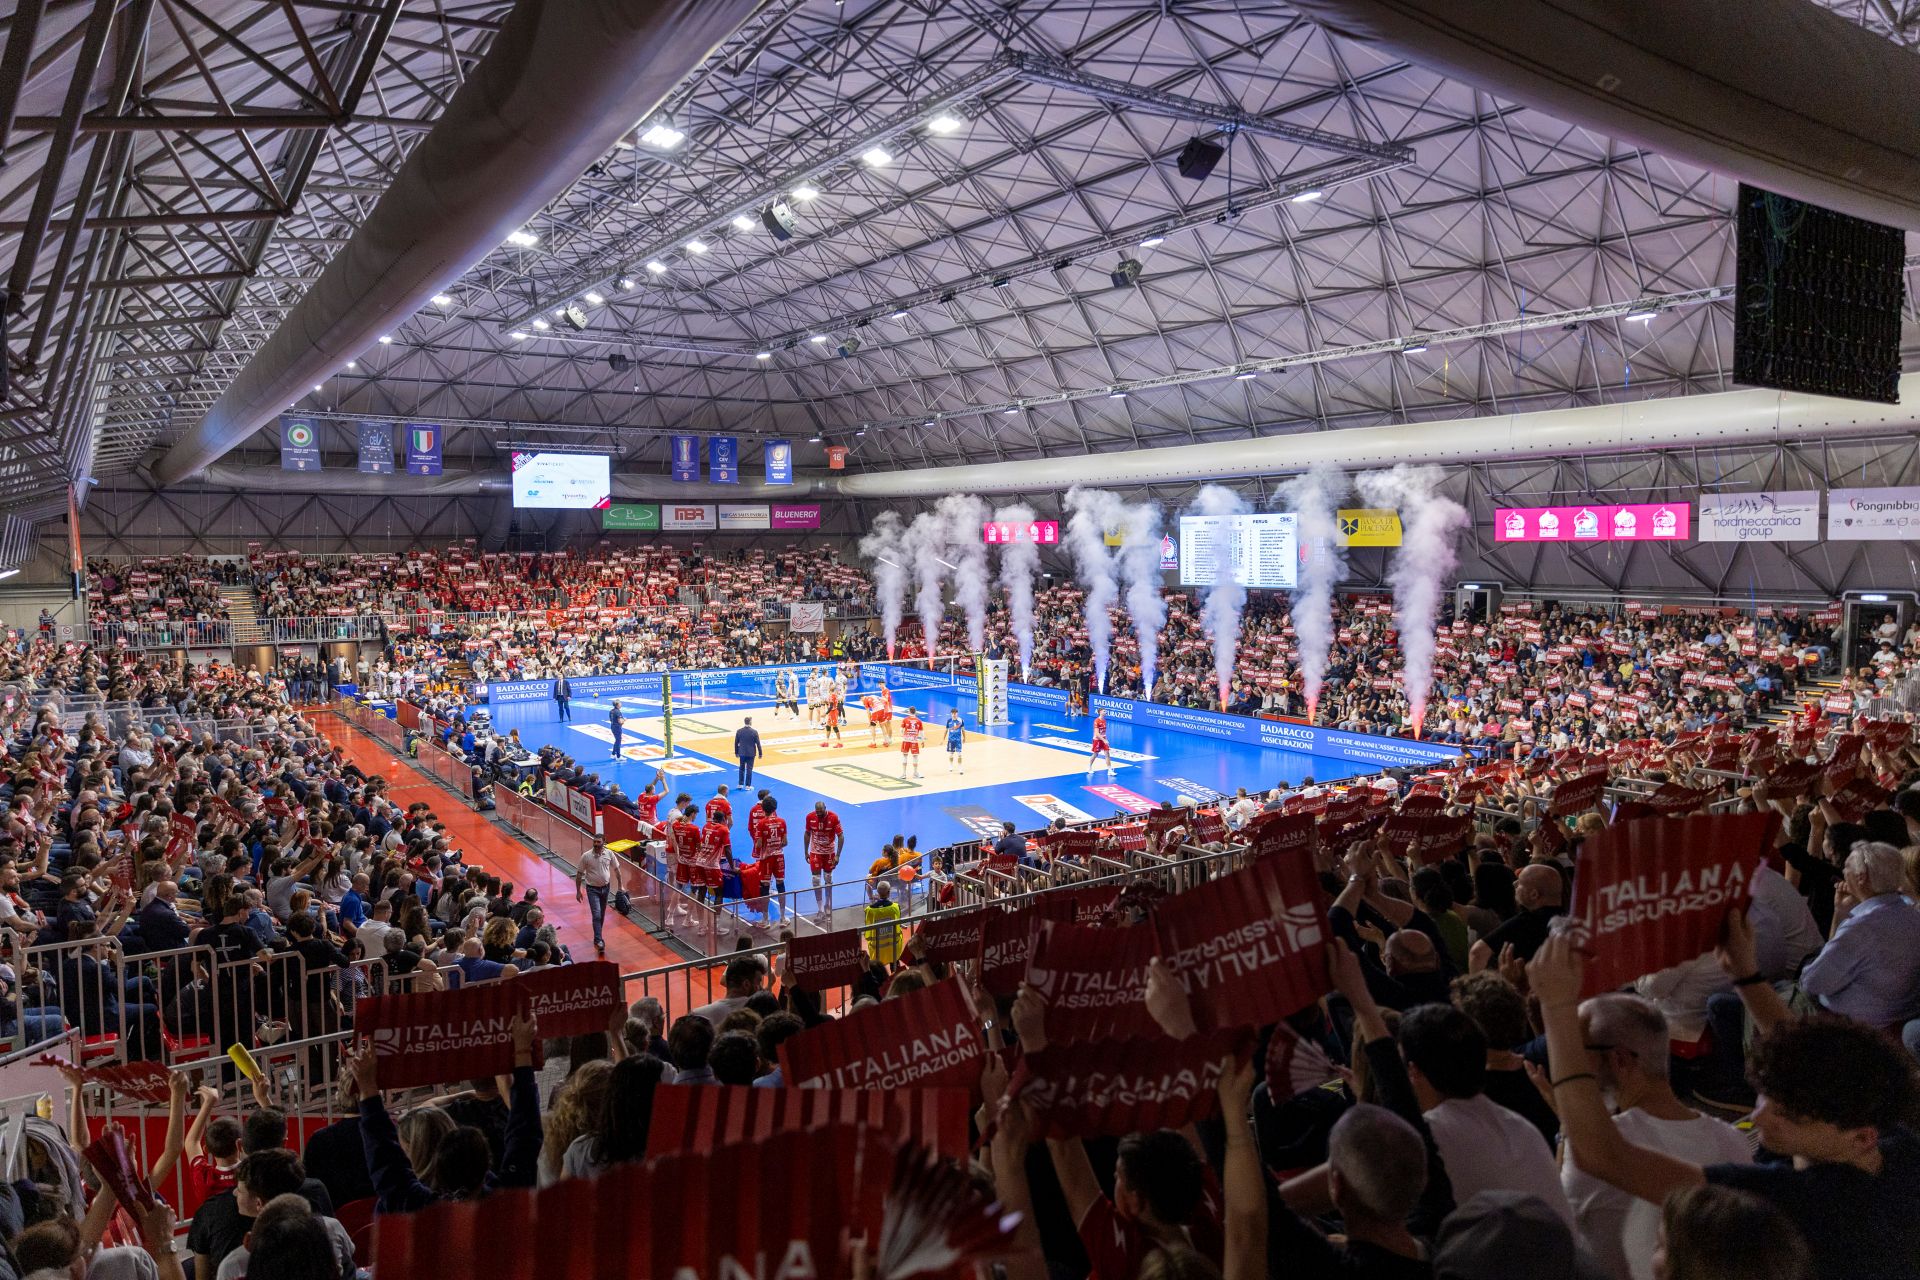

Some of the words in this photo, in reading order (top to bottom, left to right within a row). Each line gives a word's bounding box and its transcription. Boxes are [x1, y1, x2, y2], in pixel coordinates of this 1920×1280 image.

[774, 511, 818, 519] BLUENERGY
[1714, 516, 1800, 526] nordmeccanica
[1739, 527, 1773, 539] group
[475, 685, 488, 694] 10
[495, 682, 549, 693] BADARACCO
[497, 692, 548, 700] ASSICURAZIONI
[1093, 698, 1133, 711] BADARACCO
[1260, 724, 1314, 739] BADARACCO
[1261, 736, 1313, 750] ASSICURAZIONI
[1376, 753, 1398, 762] PIAZZA
[770, 828, 778, 838] 21
[938, 928, 979, 942] ITALIA
[809, 958, 858, 972] ASSICURAZIO
[1061, 968, 1150, 991] ITALIAN
[529, 985, 613, 1008] TALIANA
[404, 1032, 512, 1054] ASSICURAZIO
[836, 1022, 974, 1088] ITALIANA
